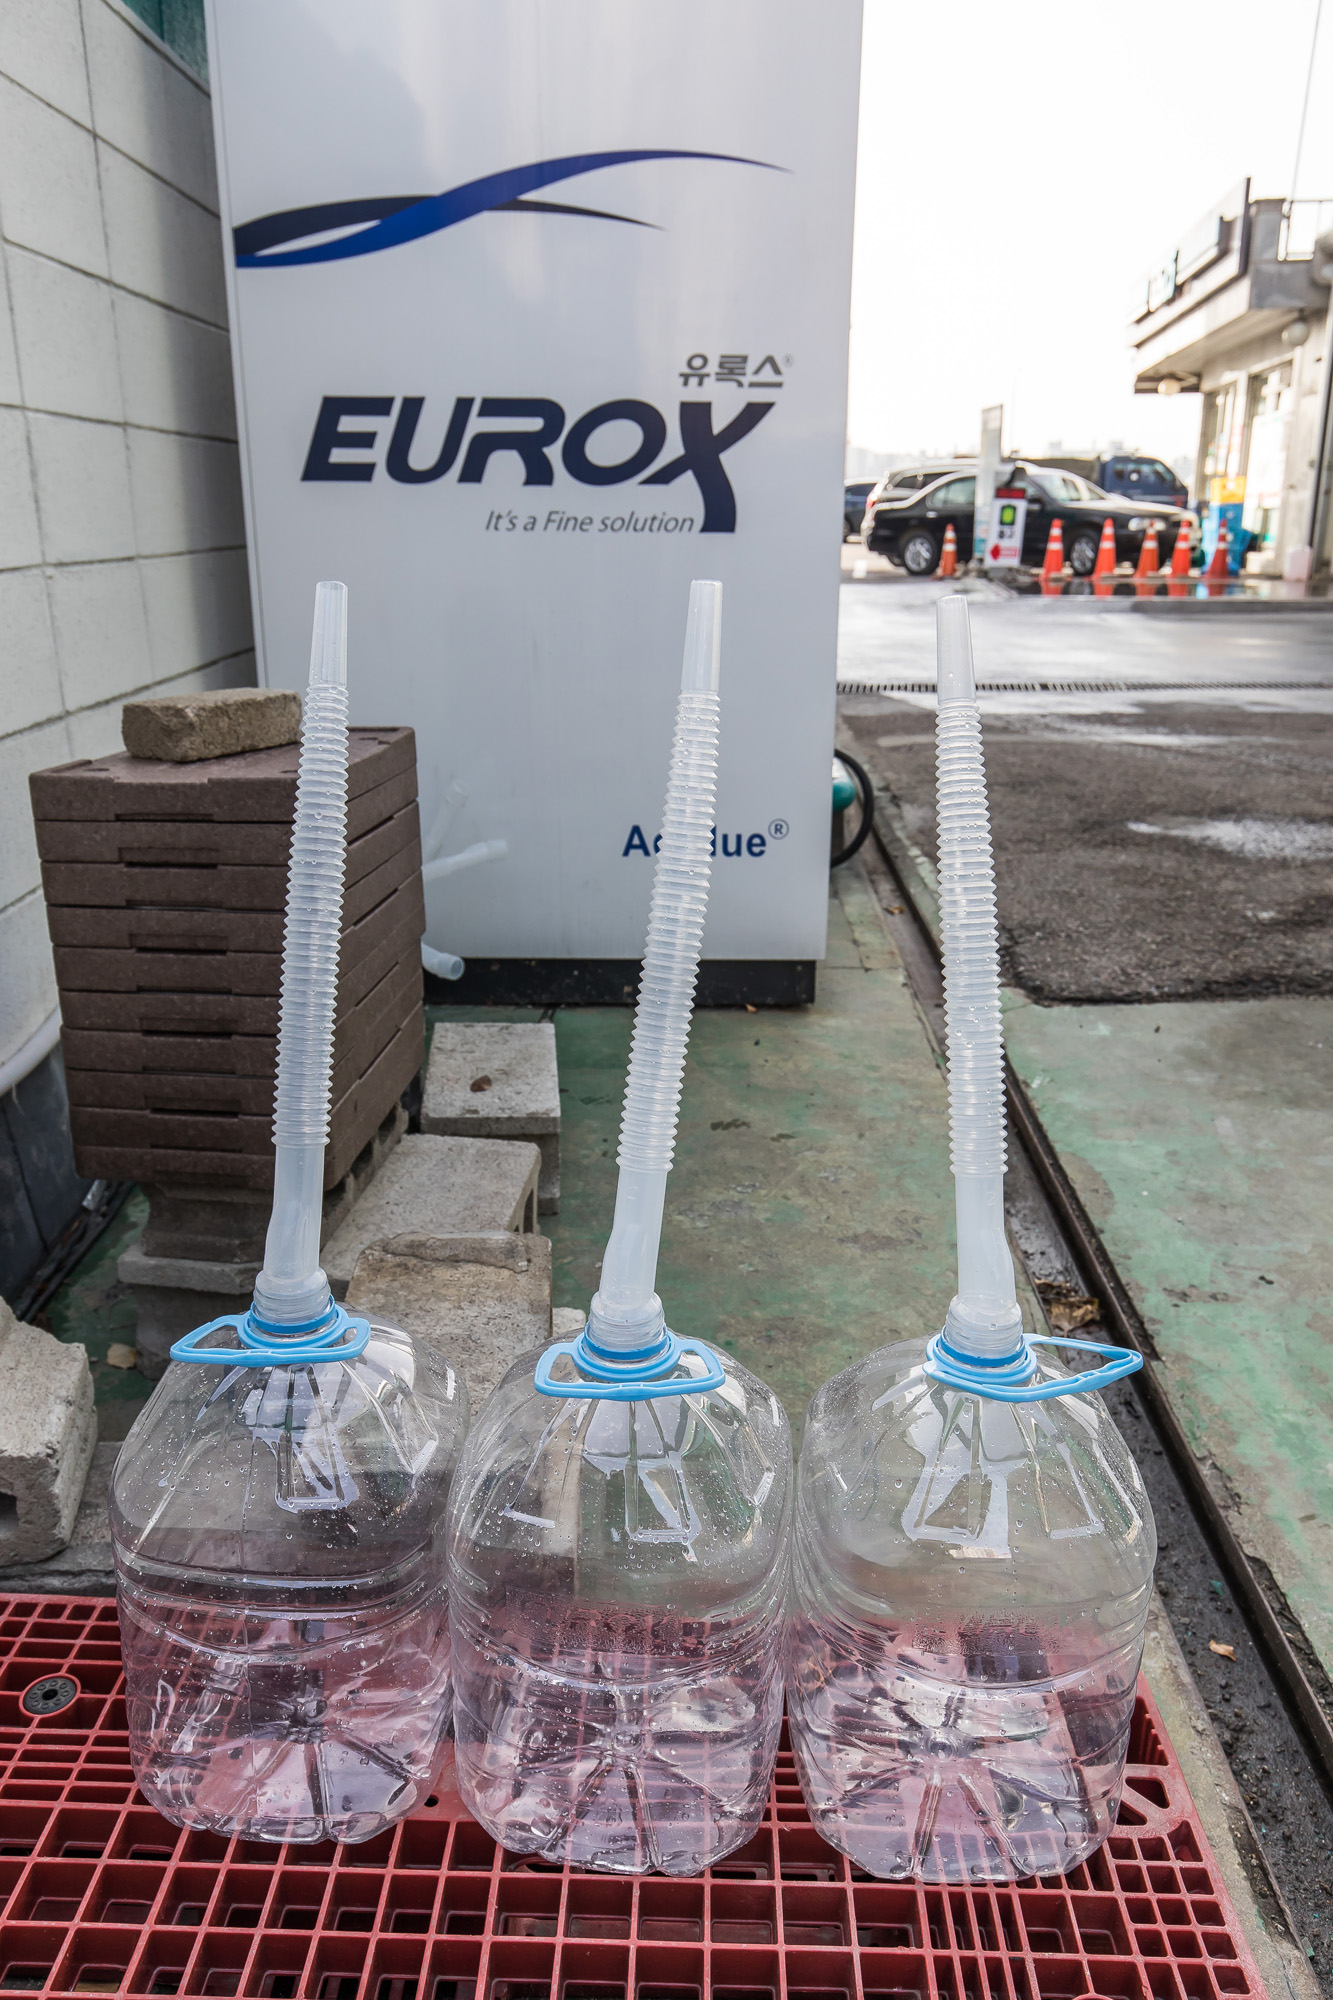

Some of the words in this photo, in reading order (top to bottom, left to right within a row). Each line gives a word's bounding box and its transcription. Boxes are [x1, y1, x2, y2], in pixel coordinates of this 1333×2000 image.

[300, 396, 776, 534] EUROX
[485, 510, 518, 532] It's
[523, 515, 538, 532] a
[543, 511, 594, 532] Fine
[598, 511, 695, 533] solution
